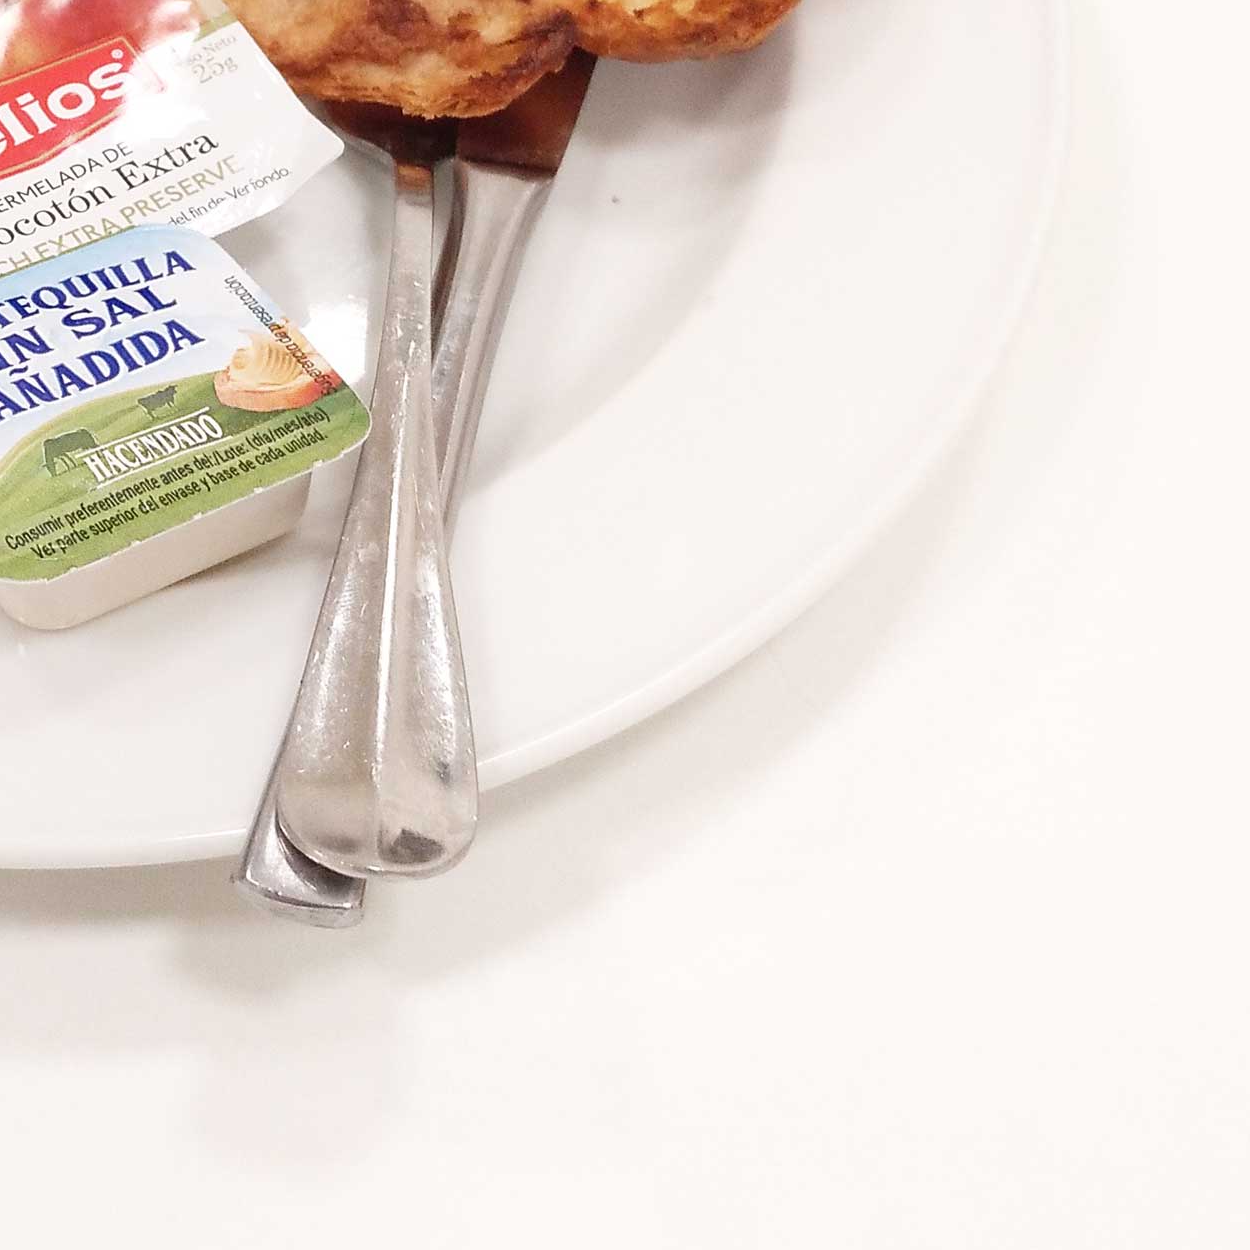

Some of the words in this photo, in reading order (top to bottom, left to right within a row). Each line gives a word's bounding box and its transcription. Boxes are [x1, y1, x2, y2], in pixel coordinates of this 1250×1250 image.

[102, 142, 133, 163] DE
[112, 134, 219, 190] Extra
[34, 217, 123, 257] EXTRA
[120, 154, 244, 225] PRESERVE
[224, 185, 250, 199] Ver
[61, 285, 178, 340] SAL
[83, 414, 224, 482] HACENDADO
[4, 514, 65, 550] Consumir
[63, 475, 161, 528] preferentemente
[160, 461, 194, 486] antes
[30, 542, 56, 559] Ver
[56, 529, 91, 554] parte
[88, 506, 139, 536] superior
[138, 495, 160, 514] del
[159, 480, 202, 507] envase
[200, 478, 212, 492] y
[206, 468, 240, 486] base
[238, 459, 258, 474] de
[254, 447, 286, 466] cada
[283, 428, 329, 453] unidad.
